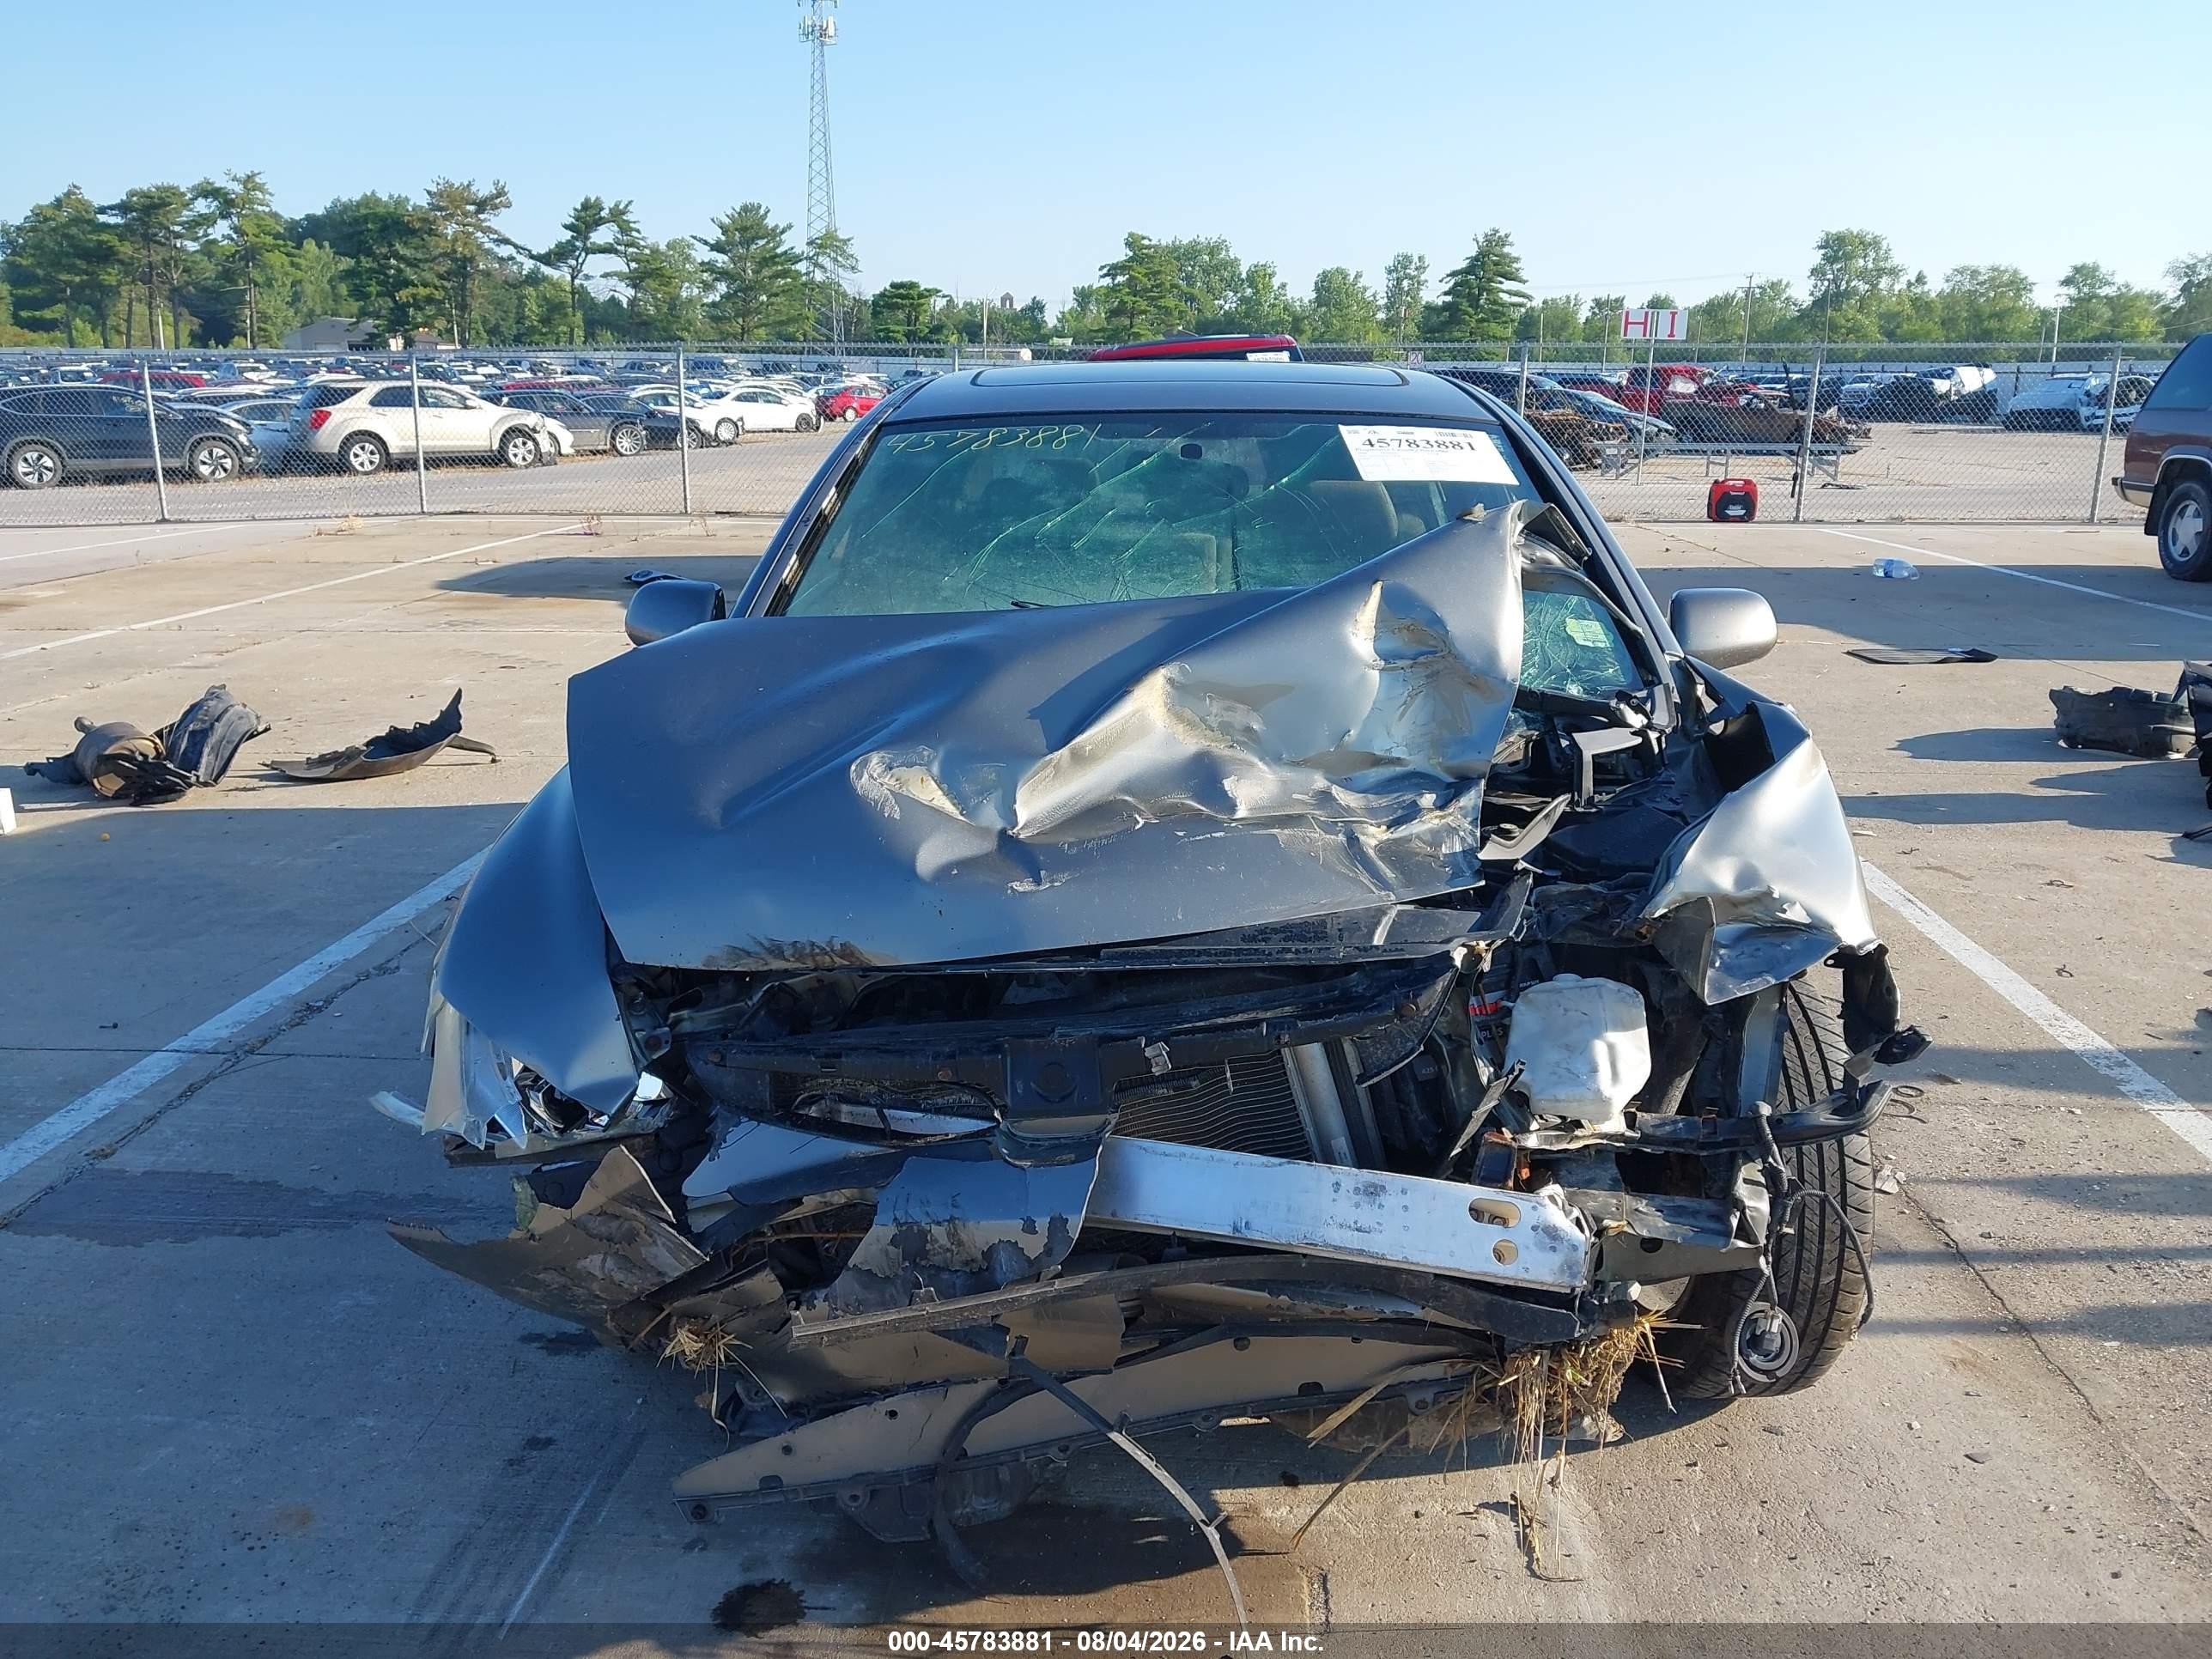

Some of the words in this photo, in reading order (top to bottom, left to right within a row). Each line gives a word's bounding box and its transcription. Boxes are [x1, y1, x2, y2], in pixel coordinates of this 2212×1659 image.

[1410, 351, 1423, 364] 20
[887, 423, 1102, 453] 45783881
[1362, 438, 1477, 451] 45783881
[1480, 1026, 1504, 1038] PLS
